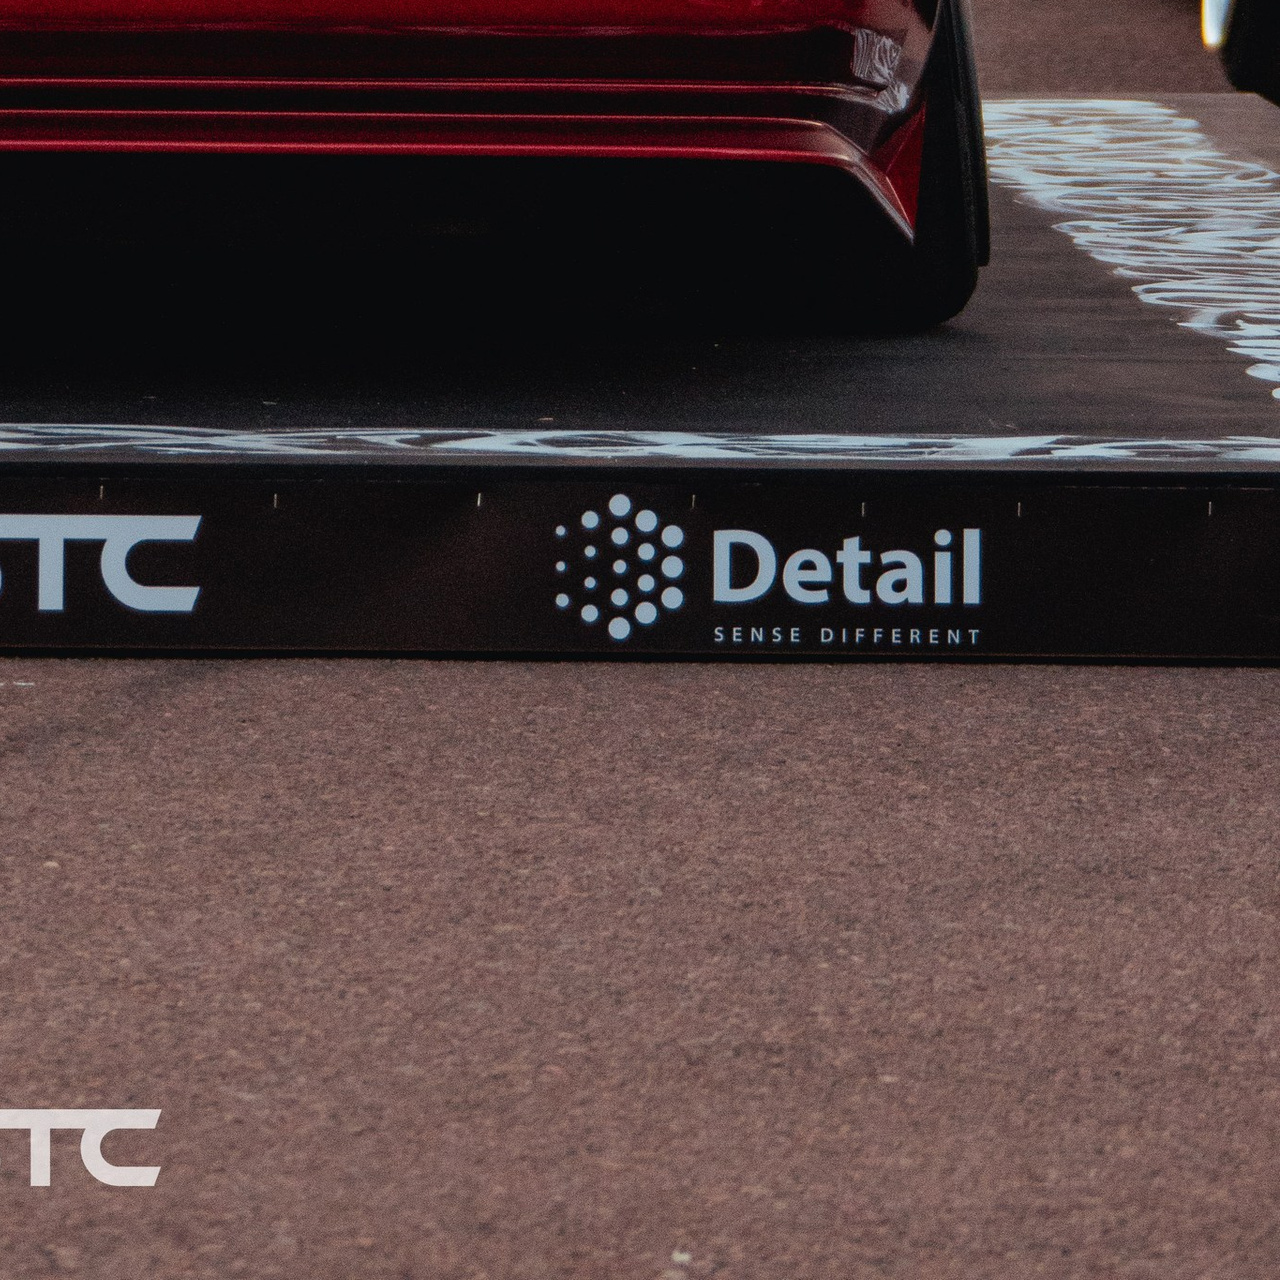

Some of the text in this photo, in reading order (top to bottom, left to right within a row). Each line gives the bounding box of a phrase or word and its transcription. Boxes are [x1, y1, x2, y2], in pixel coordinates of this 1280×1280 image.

[713, 528, 981, 605] Detail
[713, 626, 980, 645] SENSE DIFFERENT
